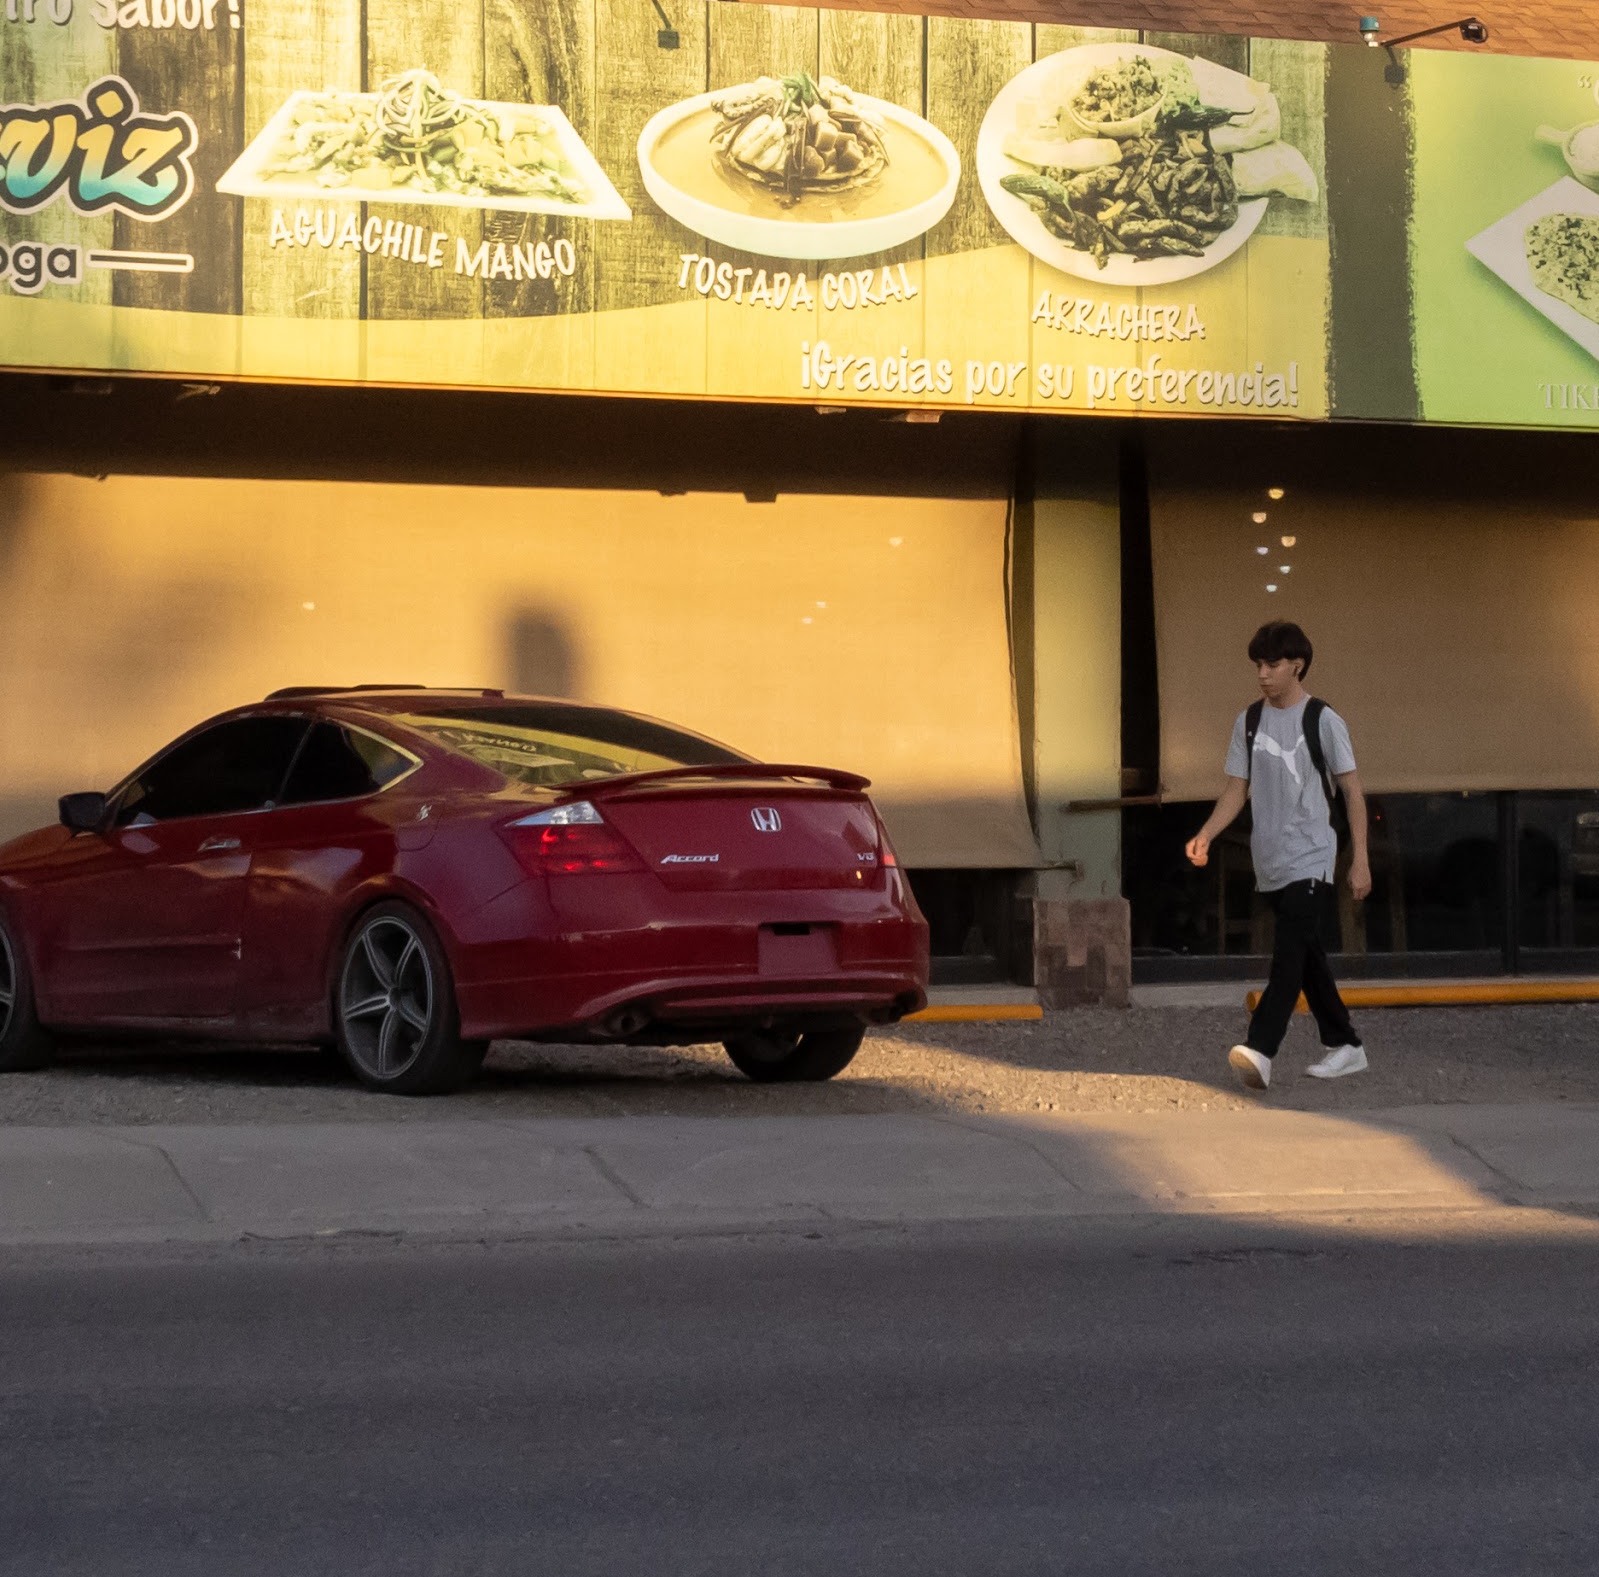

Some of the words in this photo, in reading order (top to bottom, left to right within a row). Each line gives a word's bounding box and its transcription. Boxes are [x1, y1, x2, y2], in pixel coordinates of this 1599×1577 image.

[269, 208, 448, 269] AGUACHILE
[455, 237, 577, 281] MANGO
[678, 253, 813, 311] TOSTADA
[821, 262, 919, 311] CORAL
[1031, 290, 1207, 342] ARRACHERA
[800, 340, 953, 395] ¡Gracias
[965, 359, 1028, 405] por
[1037, 359, 1074, 400] su
[1086, 354, 1300, 409] preferencia!
[659, 853, 720, 865] Accord
